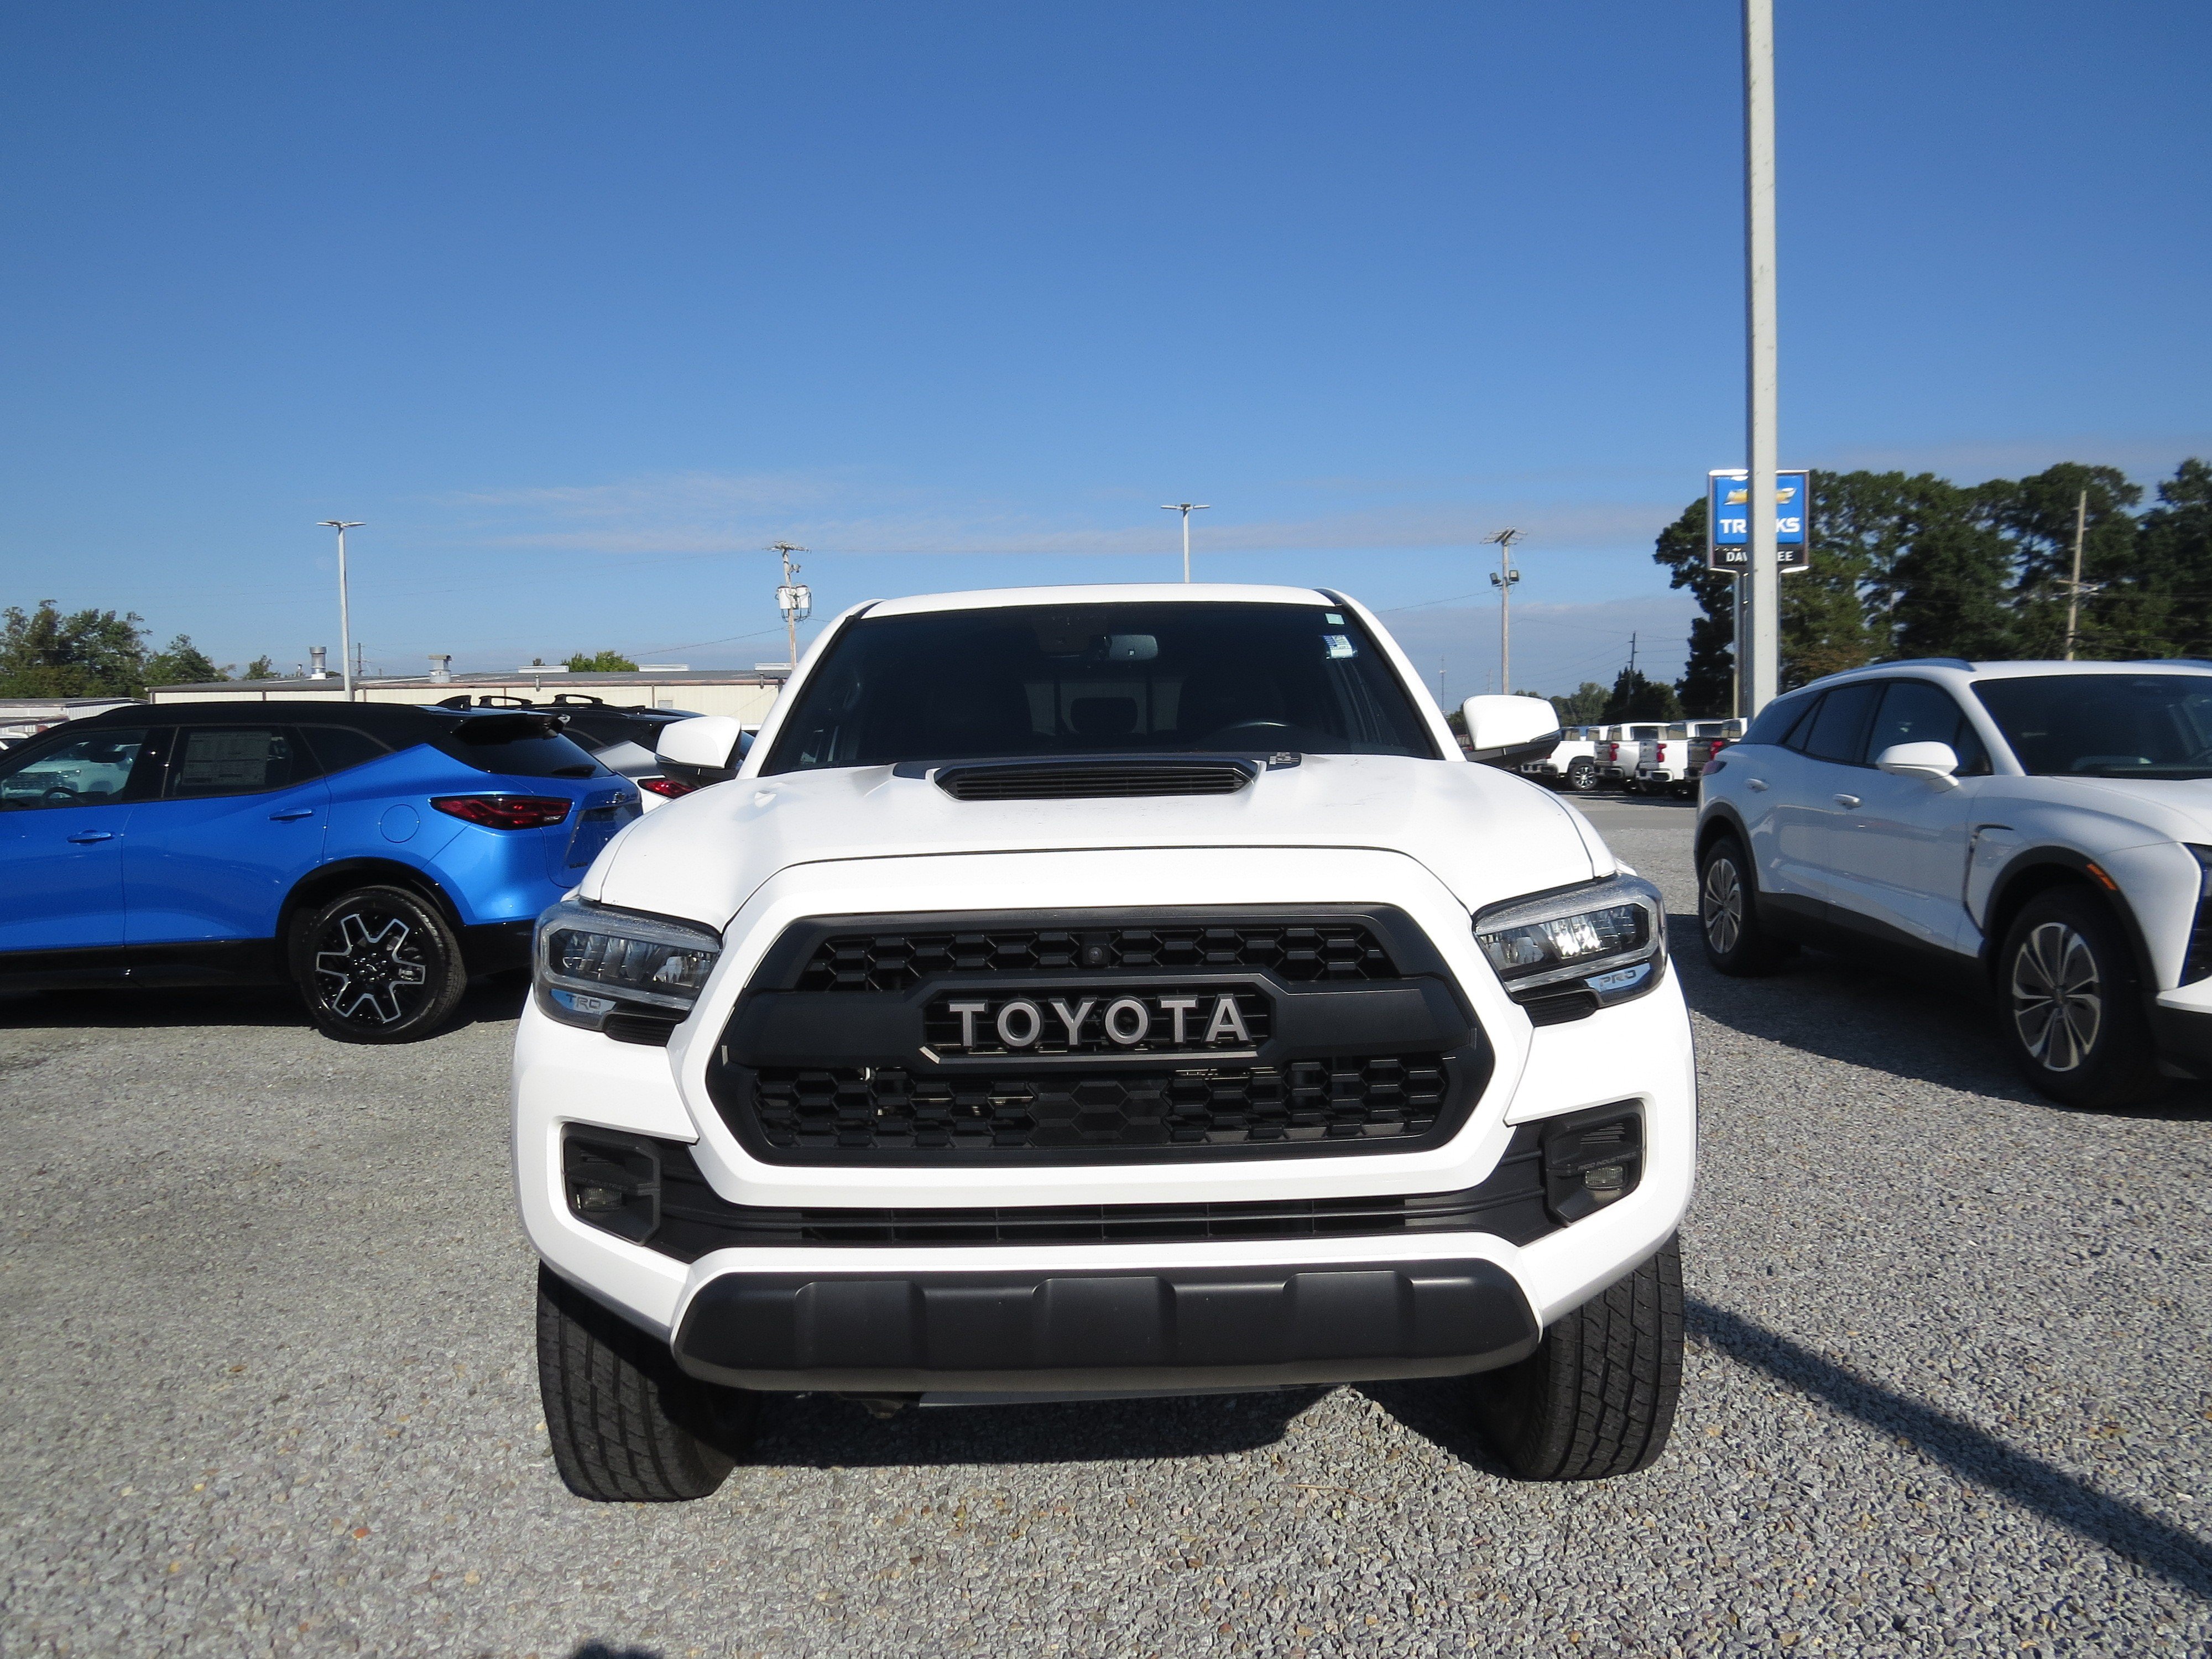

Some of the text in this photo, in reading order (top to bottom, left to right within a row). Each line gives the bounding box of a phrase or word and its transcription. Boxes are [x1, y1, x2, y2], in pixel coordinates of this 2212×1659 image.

[1719, 517, 1801, 534] TRKS
[1599, 969, 1637, 987] PRO
[565, 994, 601, 1010] TRD
[948, 993, 1252, 1047] TOYOTA
